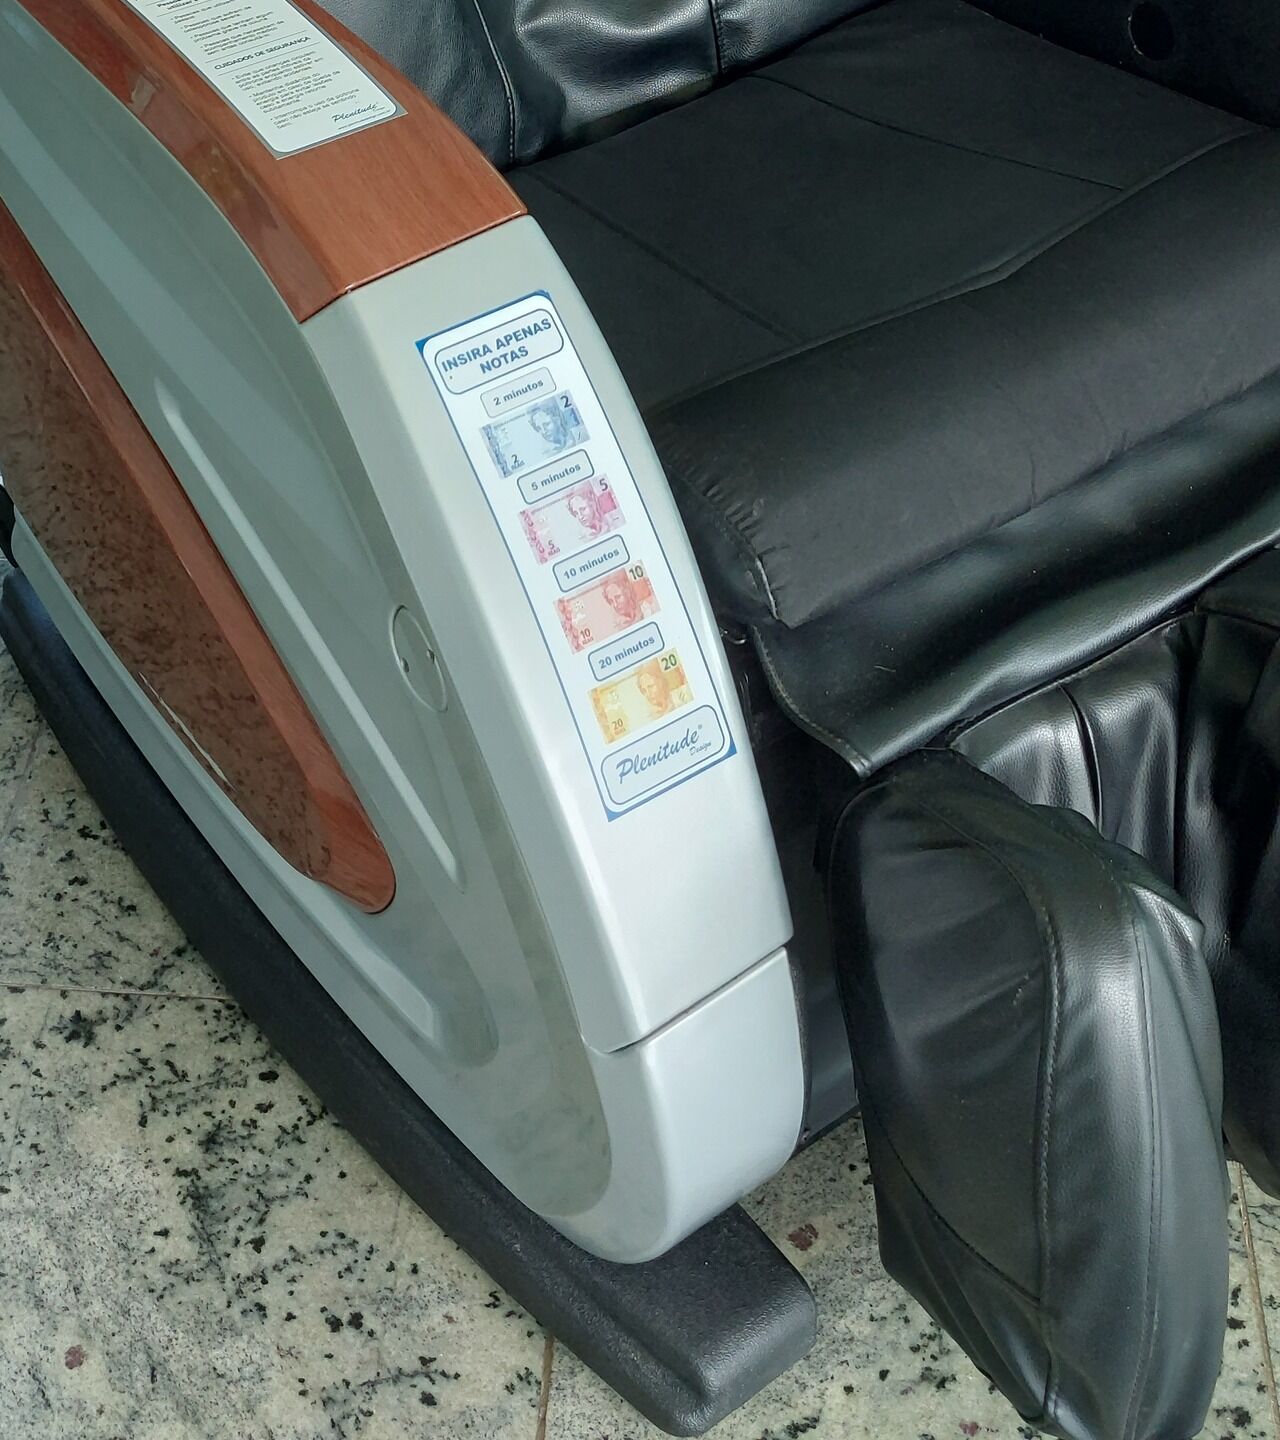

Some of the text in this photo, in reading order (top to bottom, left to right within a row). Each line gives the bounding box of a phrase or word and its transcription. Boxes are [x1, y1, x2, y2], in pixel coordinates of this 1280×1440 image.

[213, 54, 255, 70] CUIDADOS
[264, 35, 311, 53] SEGURANÇA
[441, 318, 552, 372] INSIRA APENAS
[479, 345, 529, 374] NOTAS
[493, 379, 544, 406] 2 minutos
[560, 395, 572, 408] 2
[531, 463, 581, 491] 5 minutos
[600, 478, 608, 491] 5
[563, 548, 620, 580] 10 minutos
[629, 565, 644, 580] 10
[580, 628, 591, 639] 10
[598, 635, 655, 669] 20 minutos
[660, 654, 678, 671] 20
[611, 718, 624, 731] 20
